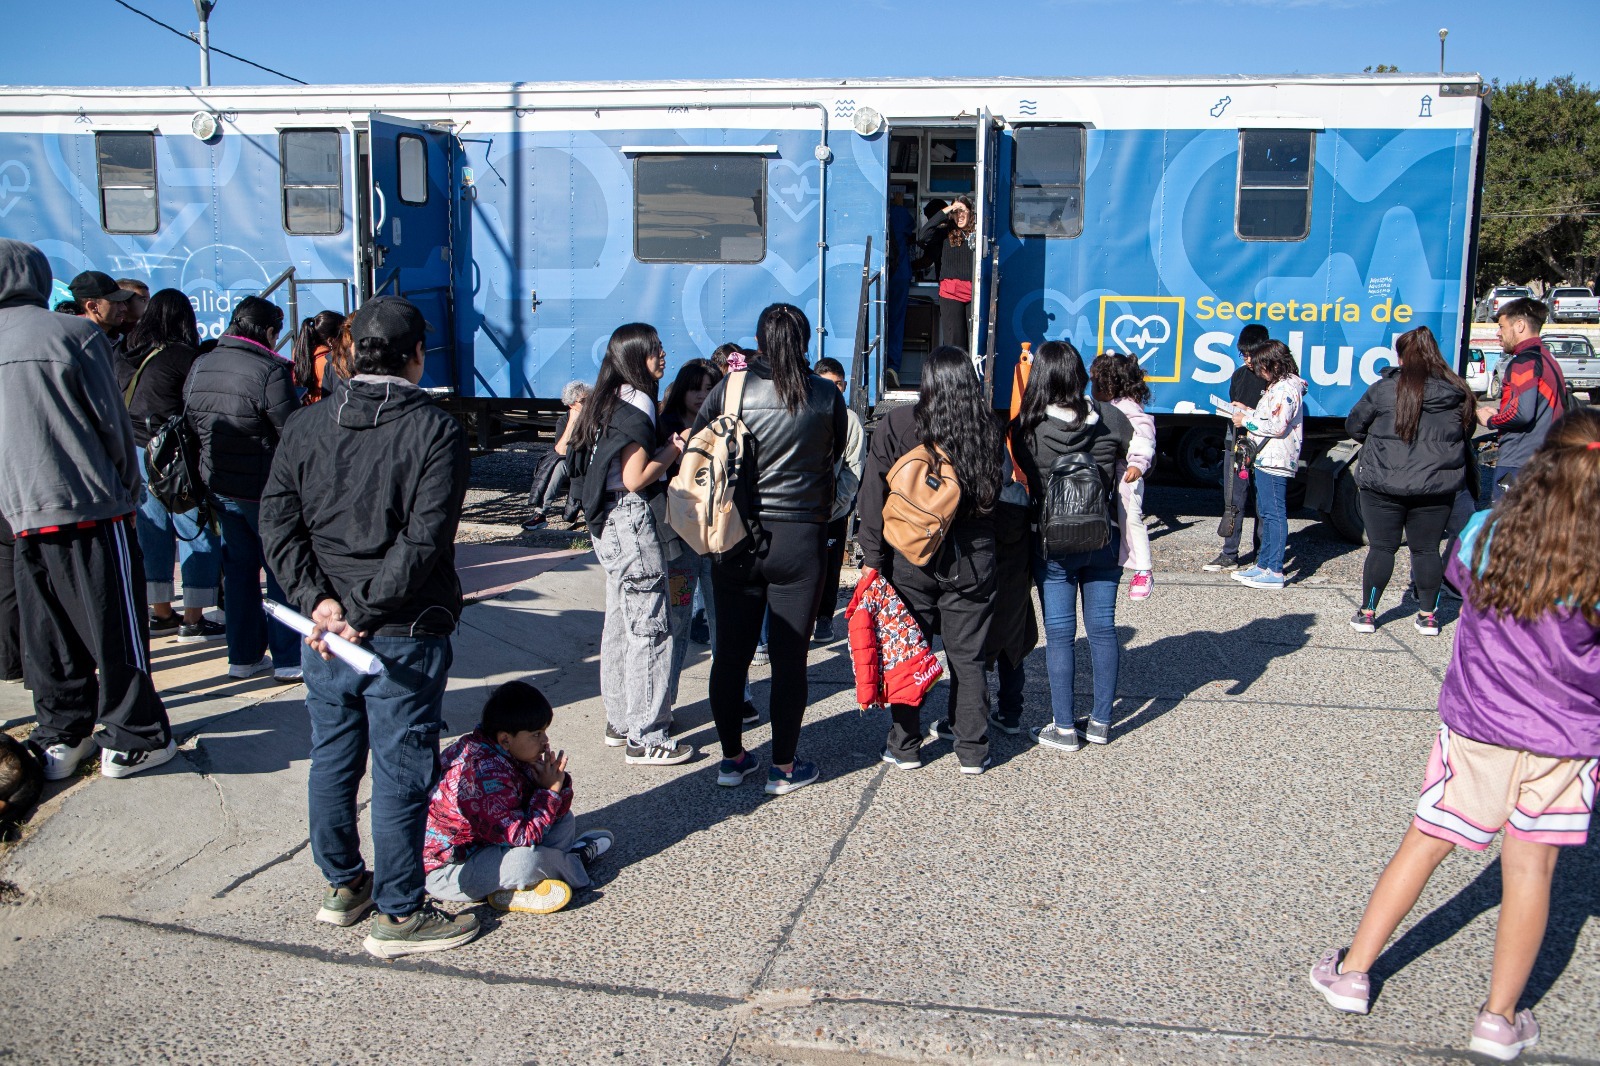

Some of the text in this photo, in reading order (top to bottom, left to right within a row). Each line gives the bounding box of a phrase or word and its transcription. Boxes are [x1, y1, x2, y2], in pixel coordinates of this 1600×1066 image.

[190, 290, 262, 312] alid
[1195, 295, 1413, 323] Secretaría de
[1191, 330, 1402, 387] Slud
